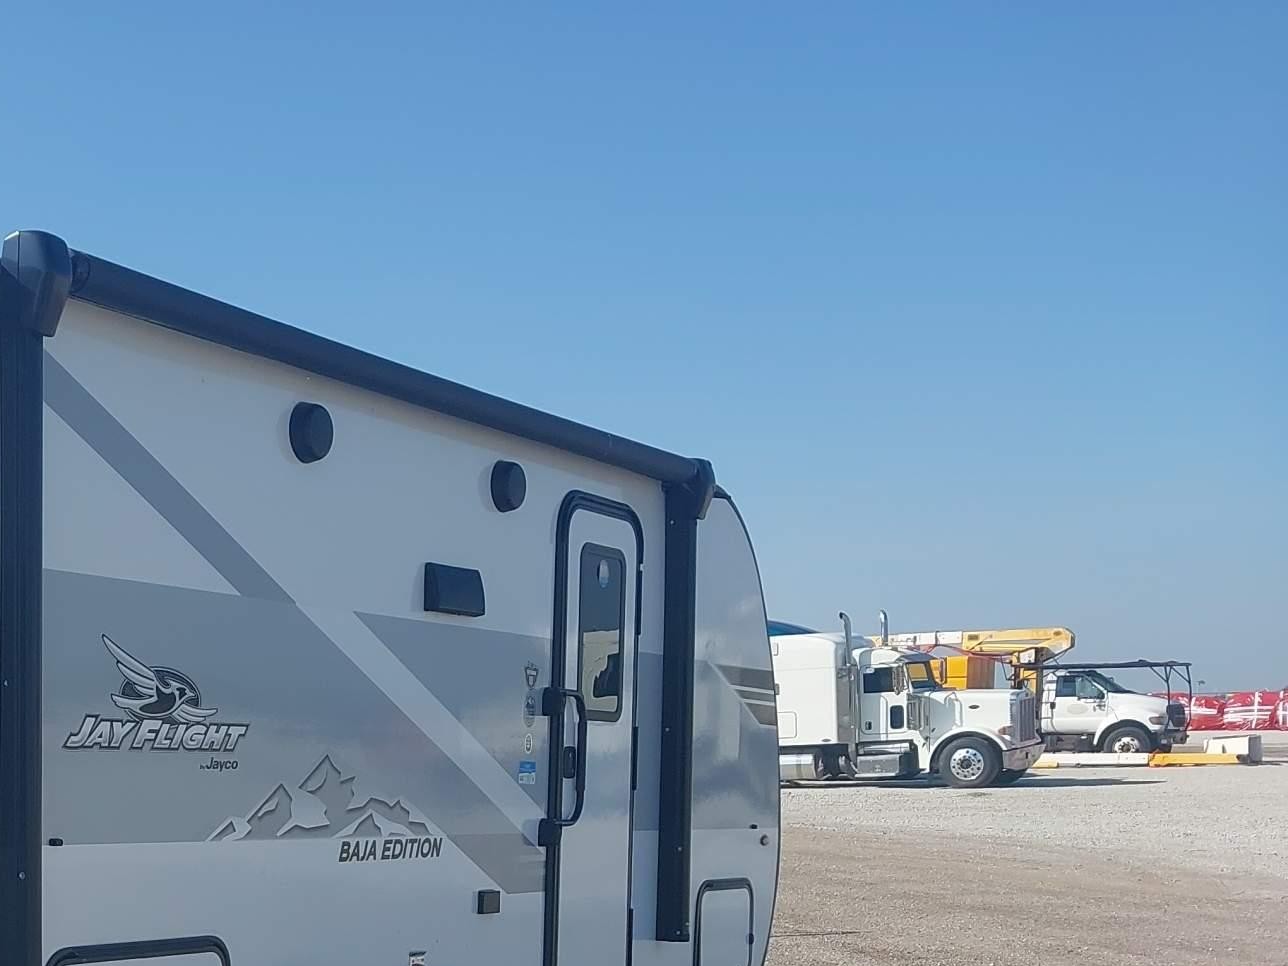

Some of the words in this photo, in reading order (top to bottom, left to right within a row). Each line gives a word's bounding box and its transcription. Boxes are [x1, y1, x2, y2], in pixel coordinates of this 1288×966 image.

[64, 714, 137, 750] JAY
[133, 718, 250, 751] FLIGHT
[206, 757, 239, 772] Jayco
[338, 839, 378, 863] BAJA
[380, 837, 444, 861] EDITION
